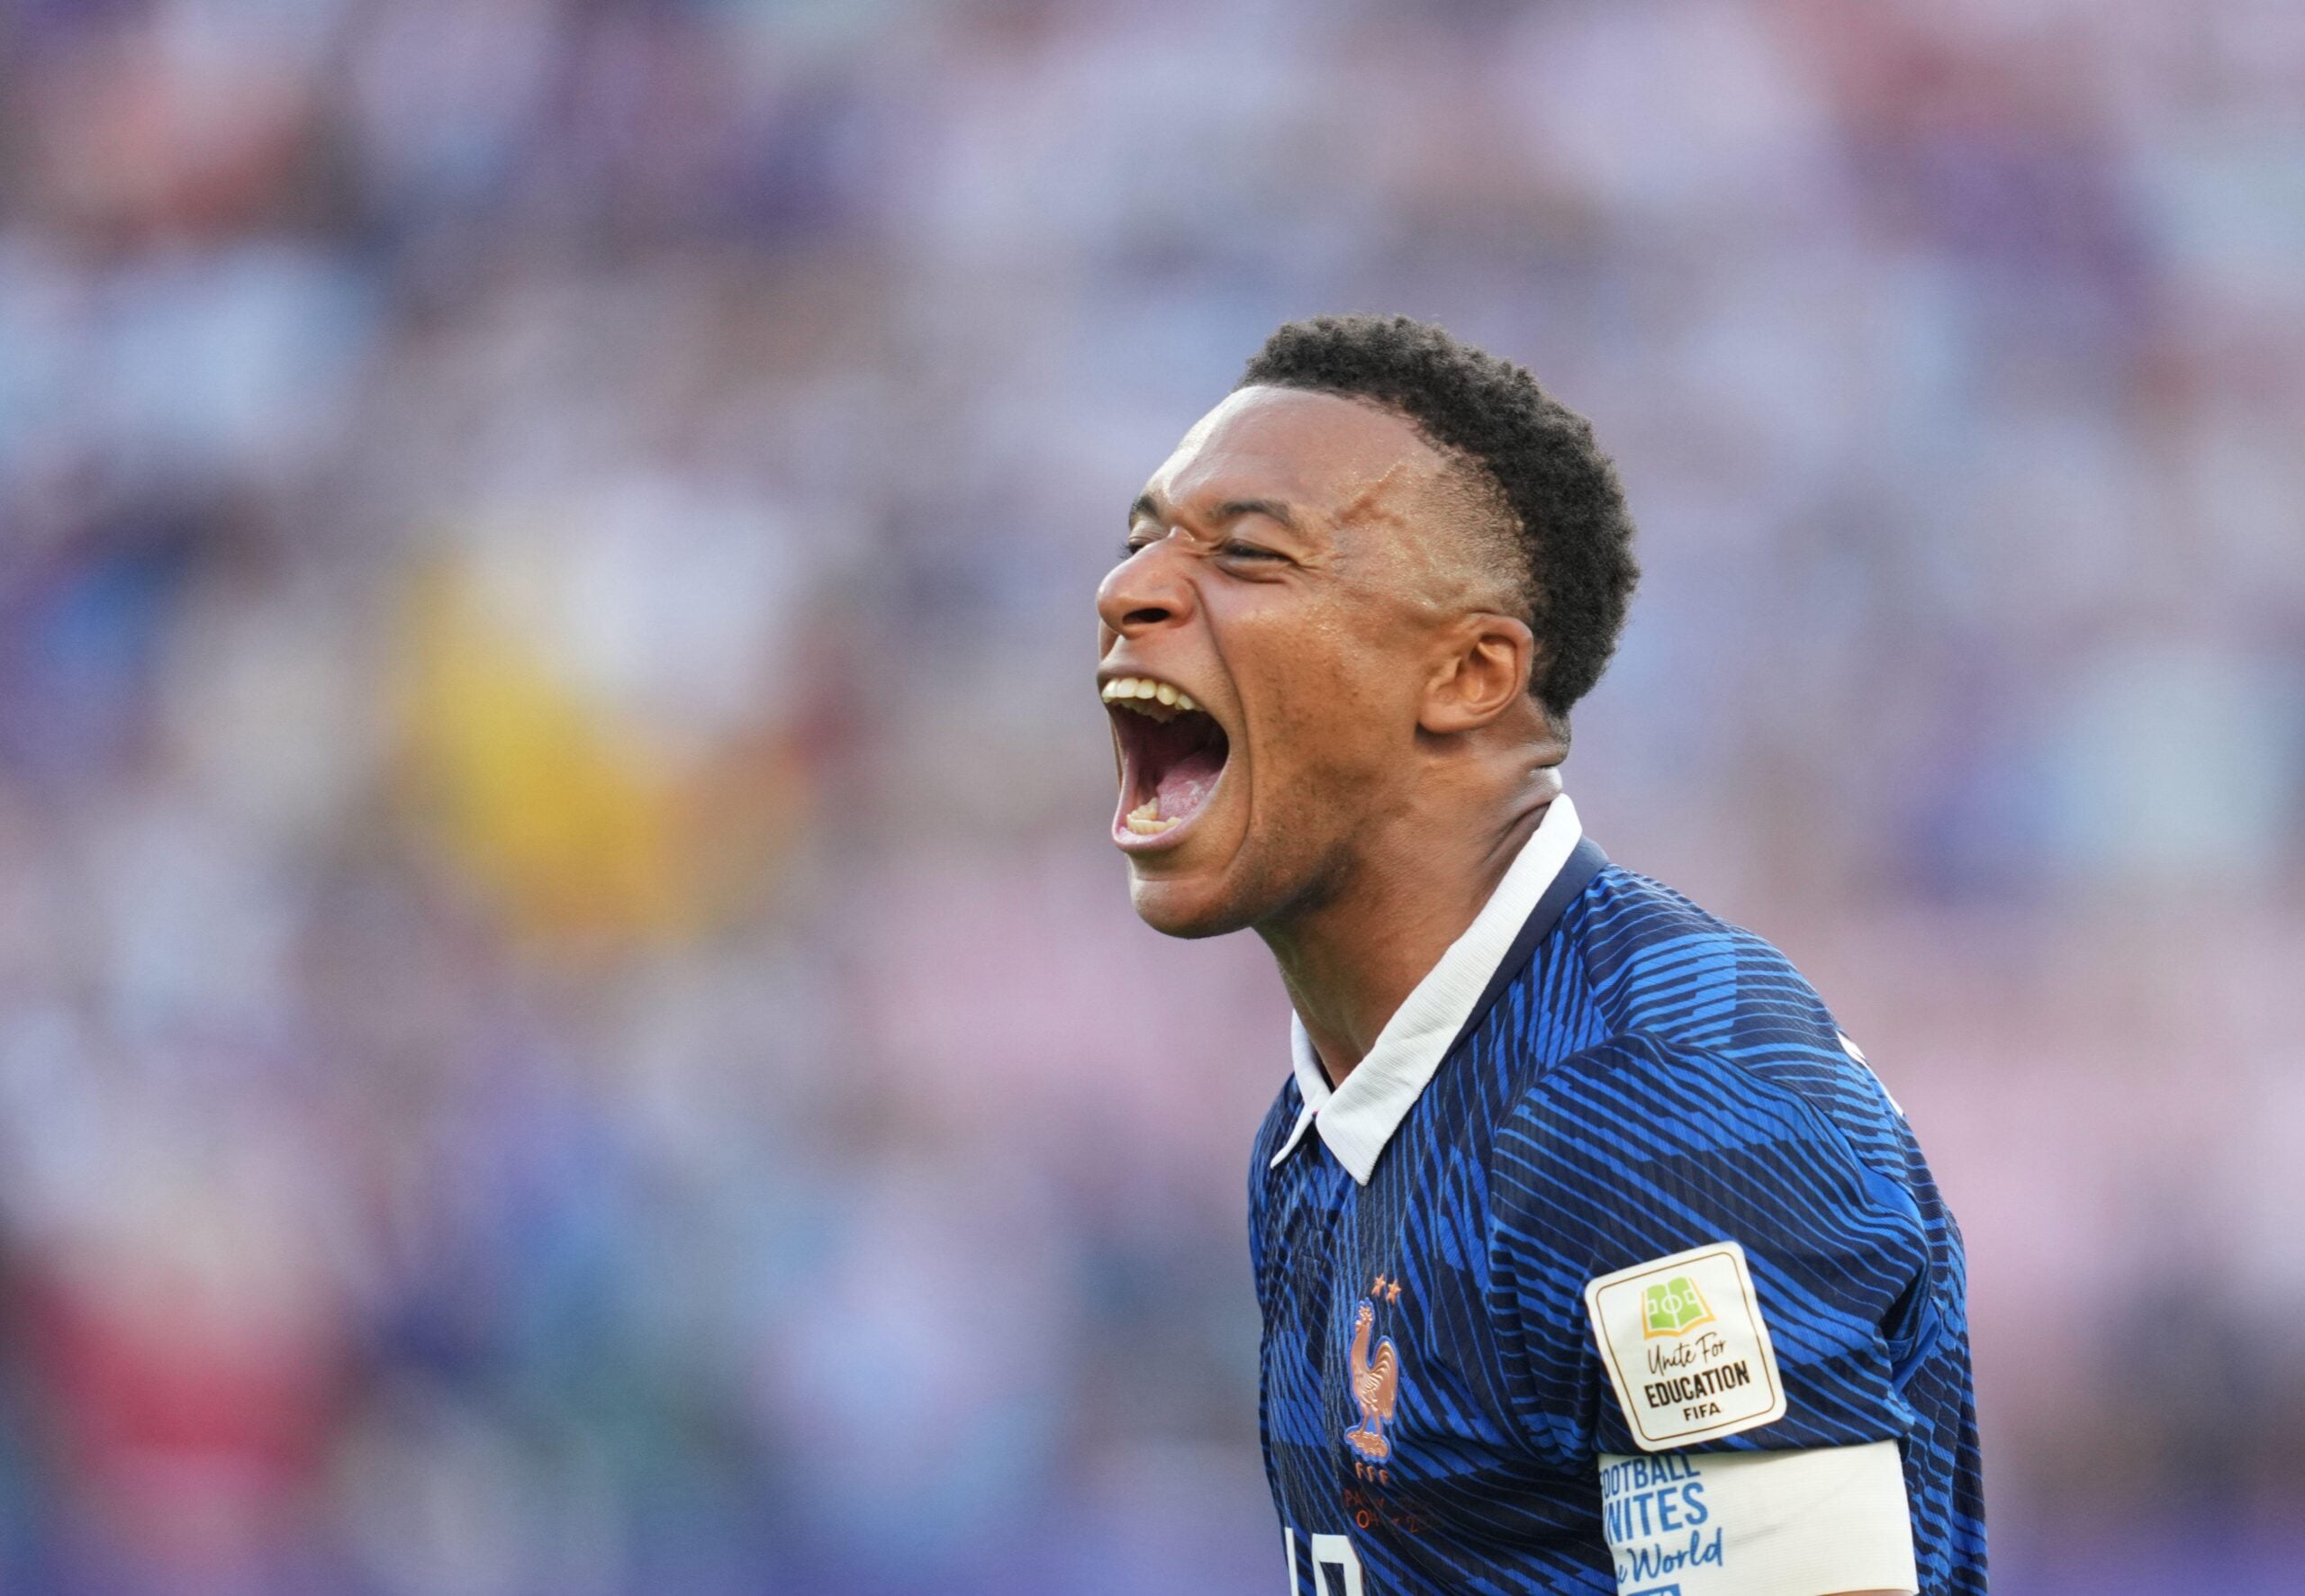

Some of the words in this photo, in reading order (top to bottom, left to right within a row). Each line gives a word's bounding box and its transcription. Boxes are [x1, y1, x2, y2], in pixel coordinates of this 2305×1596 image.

[1648, 1342, 1697, 1376] Unite
[1695, 1331, 1726, 1364] For
[1643, 1360, 1751, 1409] EDUCATION
[1683, 1402, 1721, 1421] FIFA
[1354, 1461, 1390, 1488] FFF
[1599, 1454, 1701, 1500] OOTBALL
[1604, 1482, 1709, 1546] NITES
[1626, 1527, 1723, 1582] World
